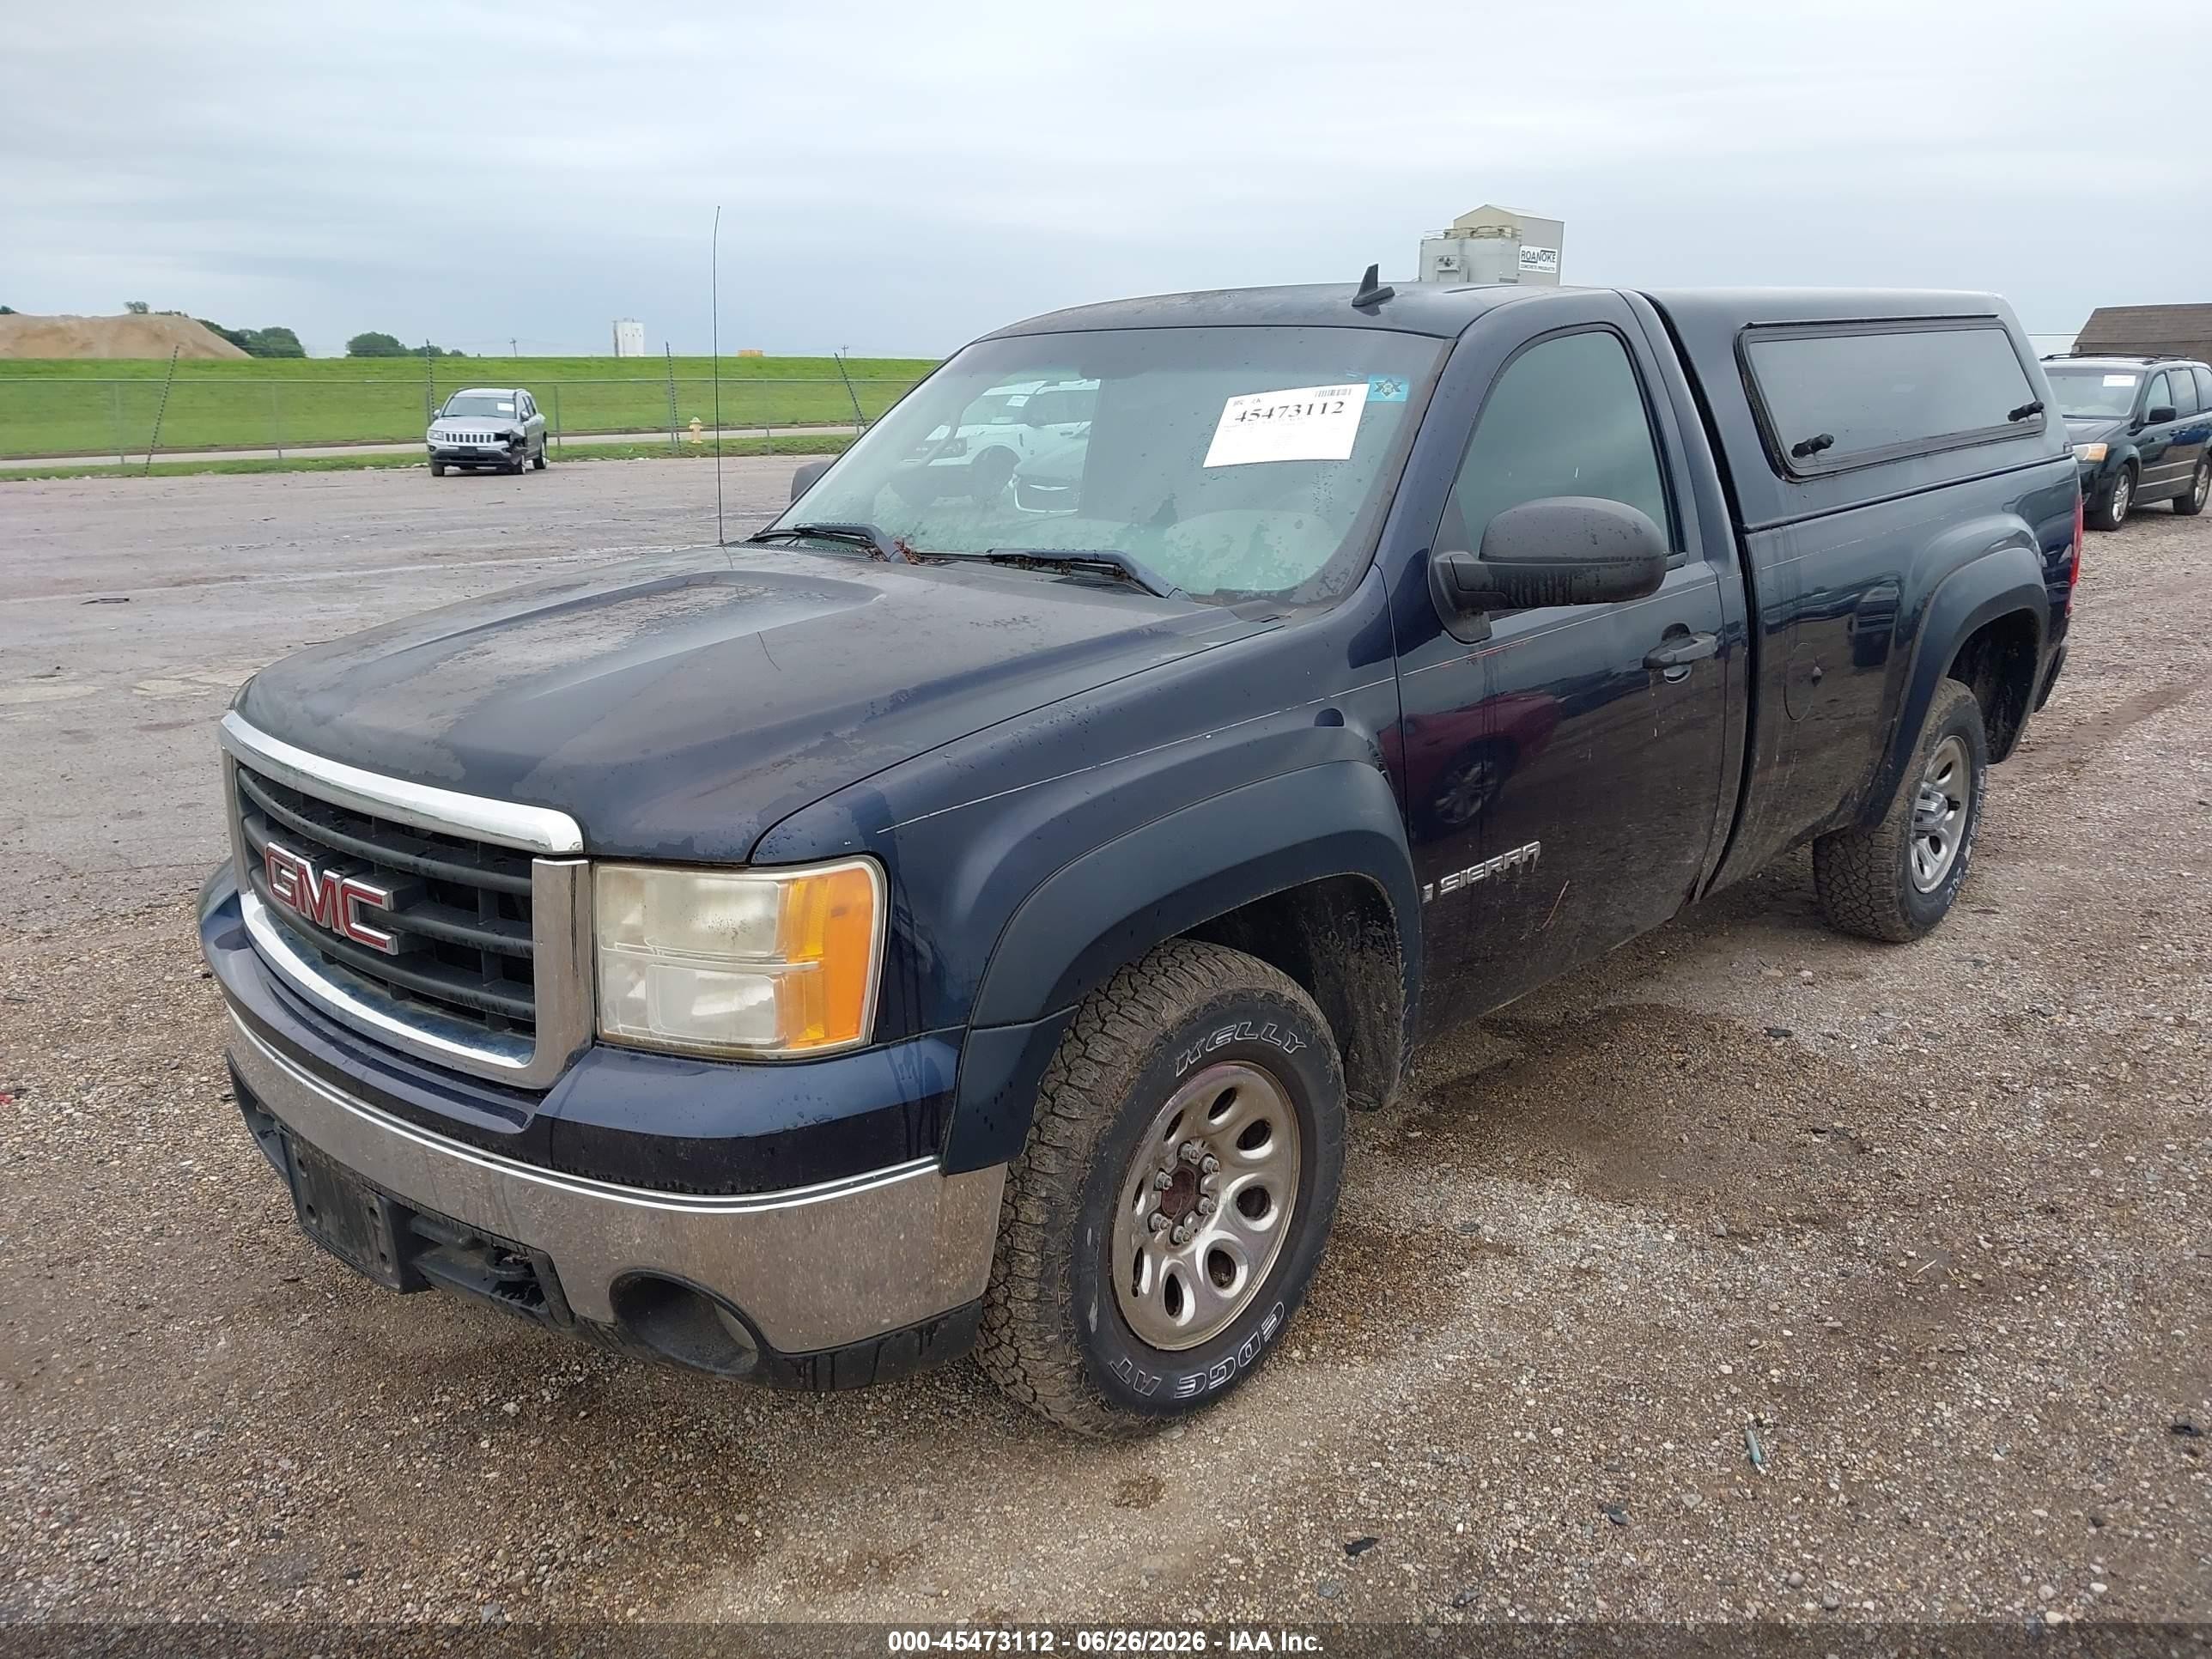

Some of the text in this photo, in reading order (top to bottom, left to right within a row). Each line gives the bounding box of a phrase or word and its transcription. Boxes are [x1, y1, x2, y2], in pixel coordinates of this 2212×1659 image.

[1521, 250, 1556, 263] ROANOKE
[1235, 401, 1345, 422] 45473112
[1440, 841, 1541, 895] SIERRA
[264, 842, 398, 956] GMC
[1175, 1021, 1307, 1078] KELLY
[1108, 1301, 1285, 1399] EDGE AT
